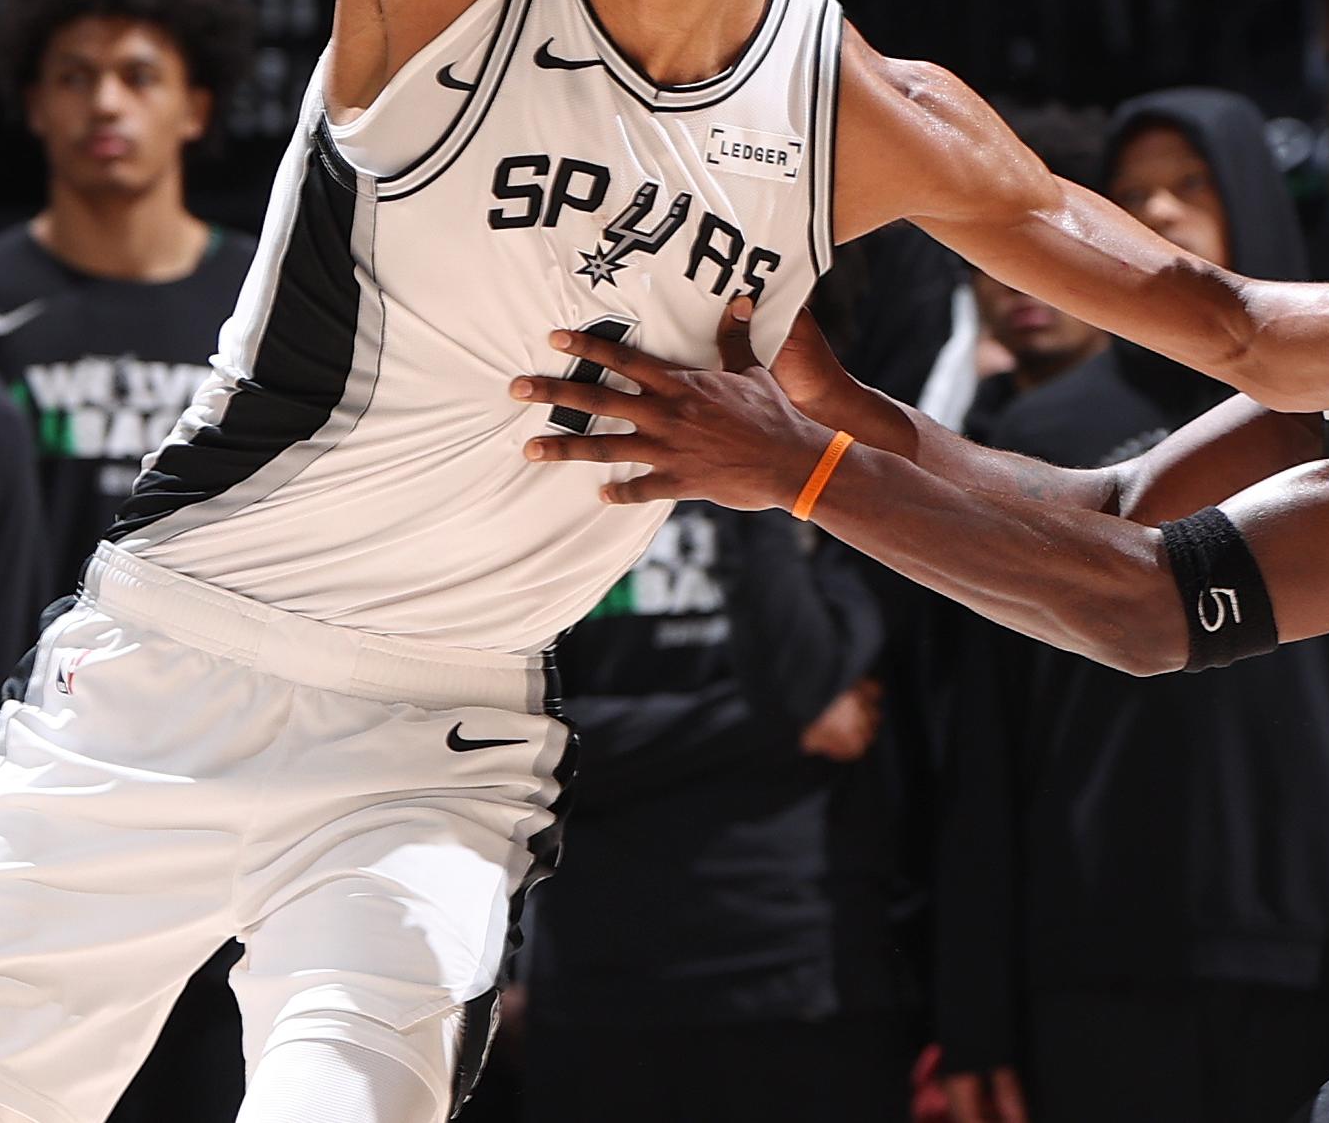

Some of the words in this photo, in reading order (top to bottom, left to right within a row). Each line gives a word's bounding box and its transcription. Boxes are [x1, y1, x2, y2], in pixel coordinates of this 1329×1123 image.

[720, 140, 788, 166] LEDGER
[487, 153, 781, 306] SPURS
[546, 312, 640, 436] 1
[1197, 586, 1242, 633] 5
